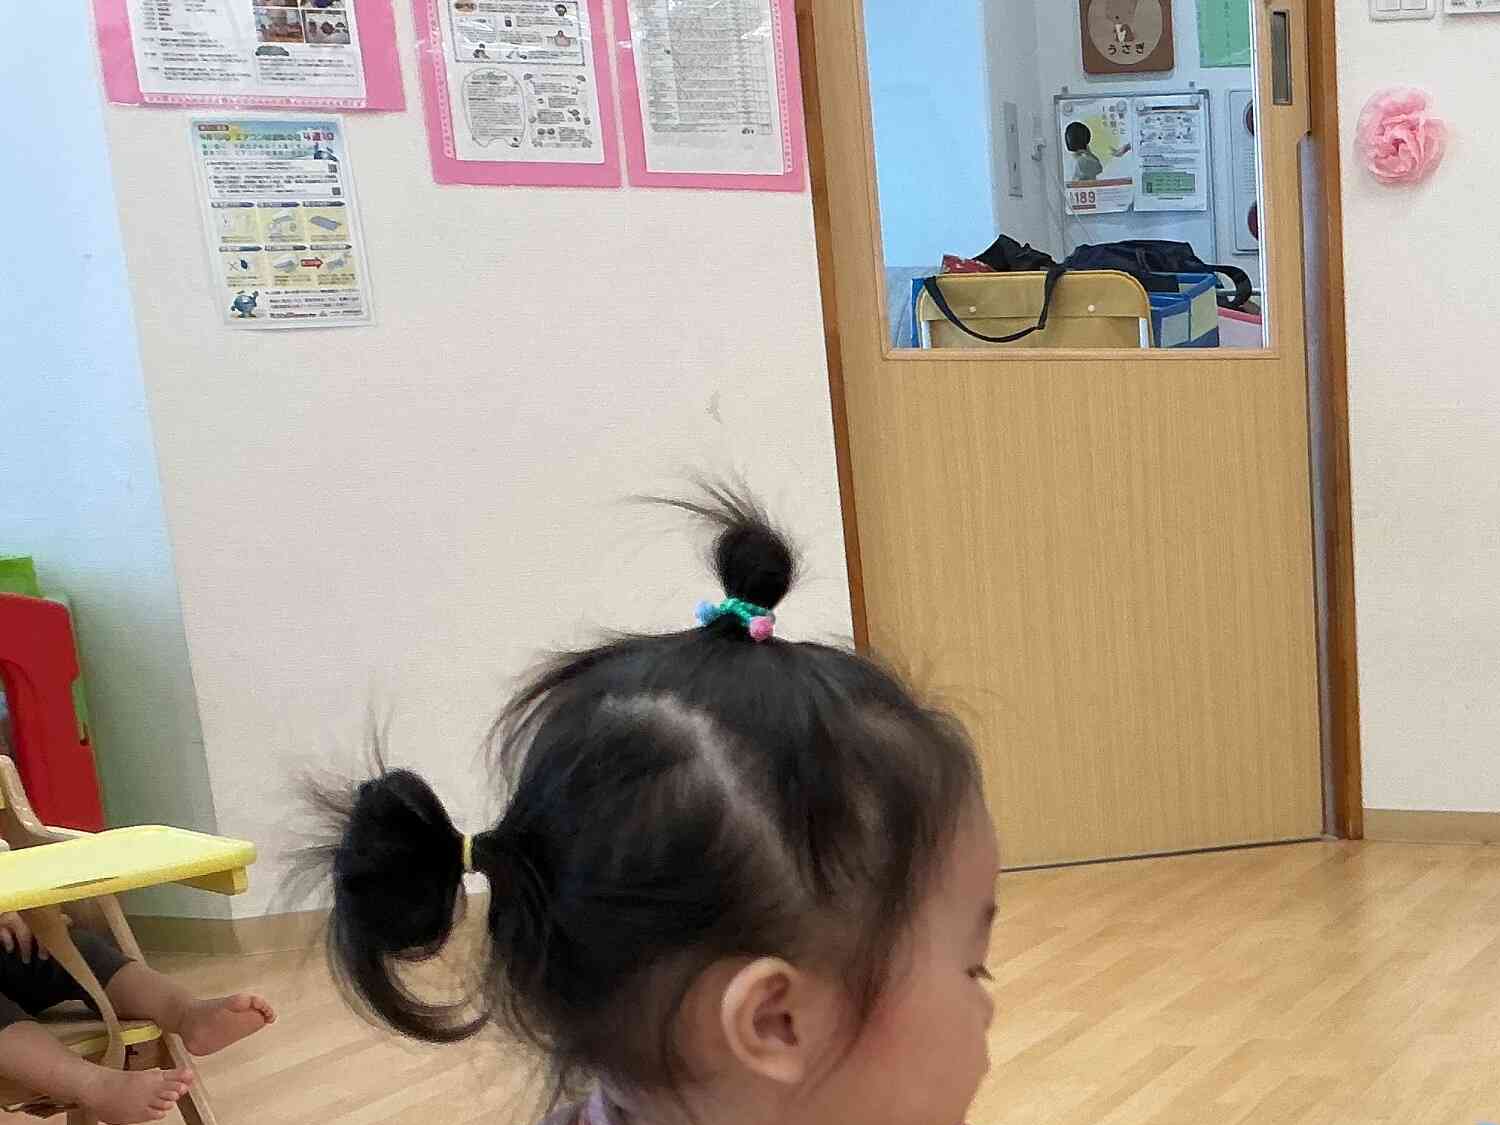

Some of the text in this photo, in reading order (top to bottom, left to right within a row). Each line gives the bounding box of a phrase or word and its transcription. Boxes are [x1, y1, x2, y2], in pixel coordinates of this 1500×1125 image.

[1108, 43, 1145, 55] うさぎ
[1074, 191, 1096, 204] 189
